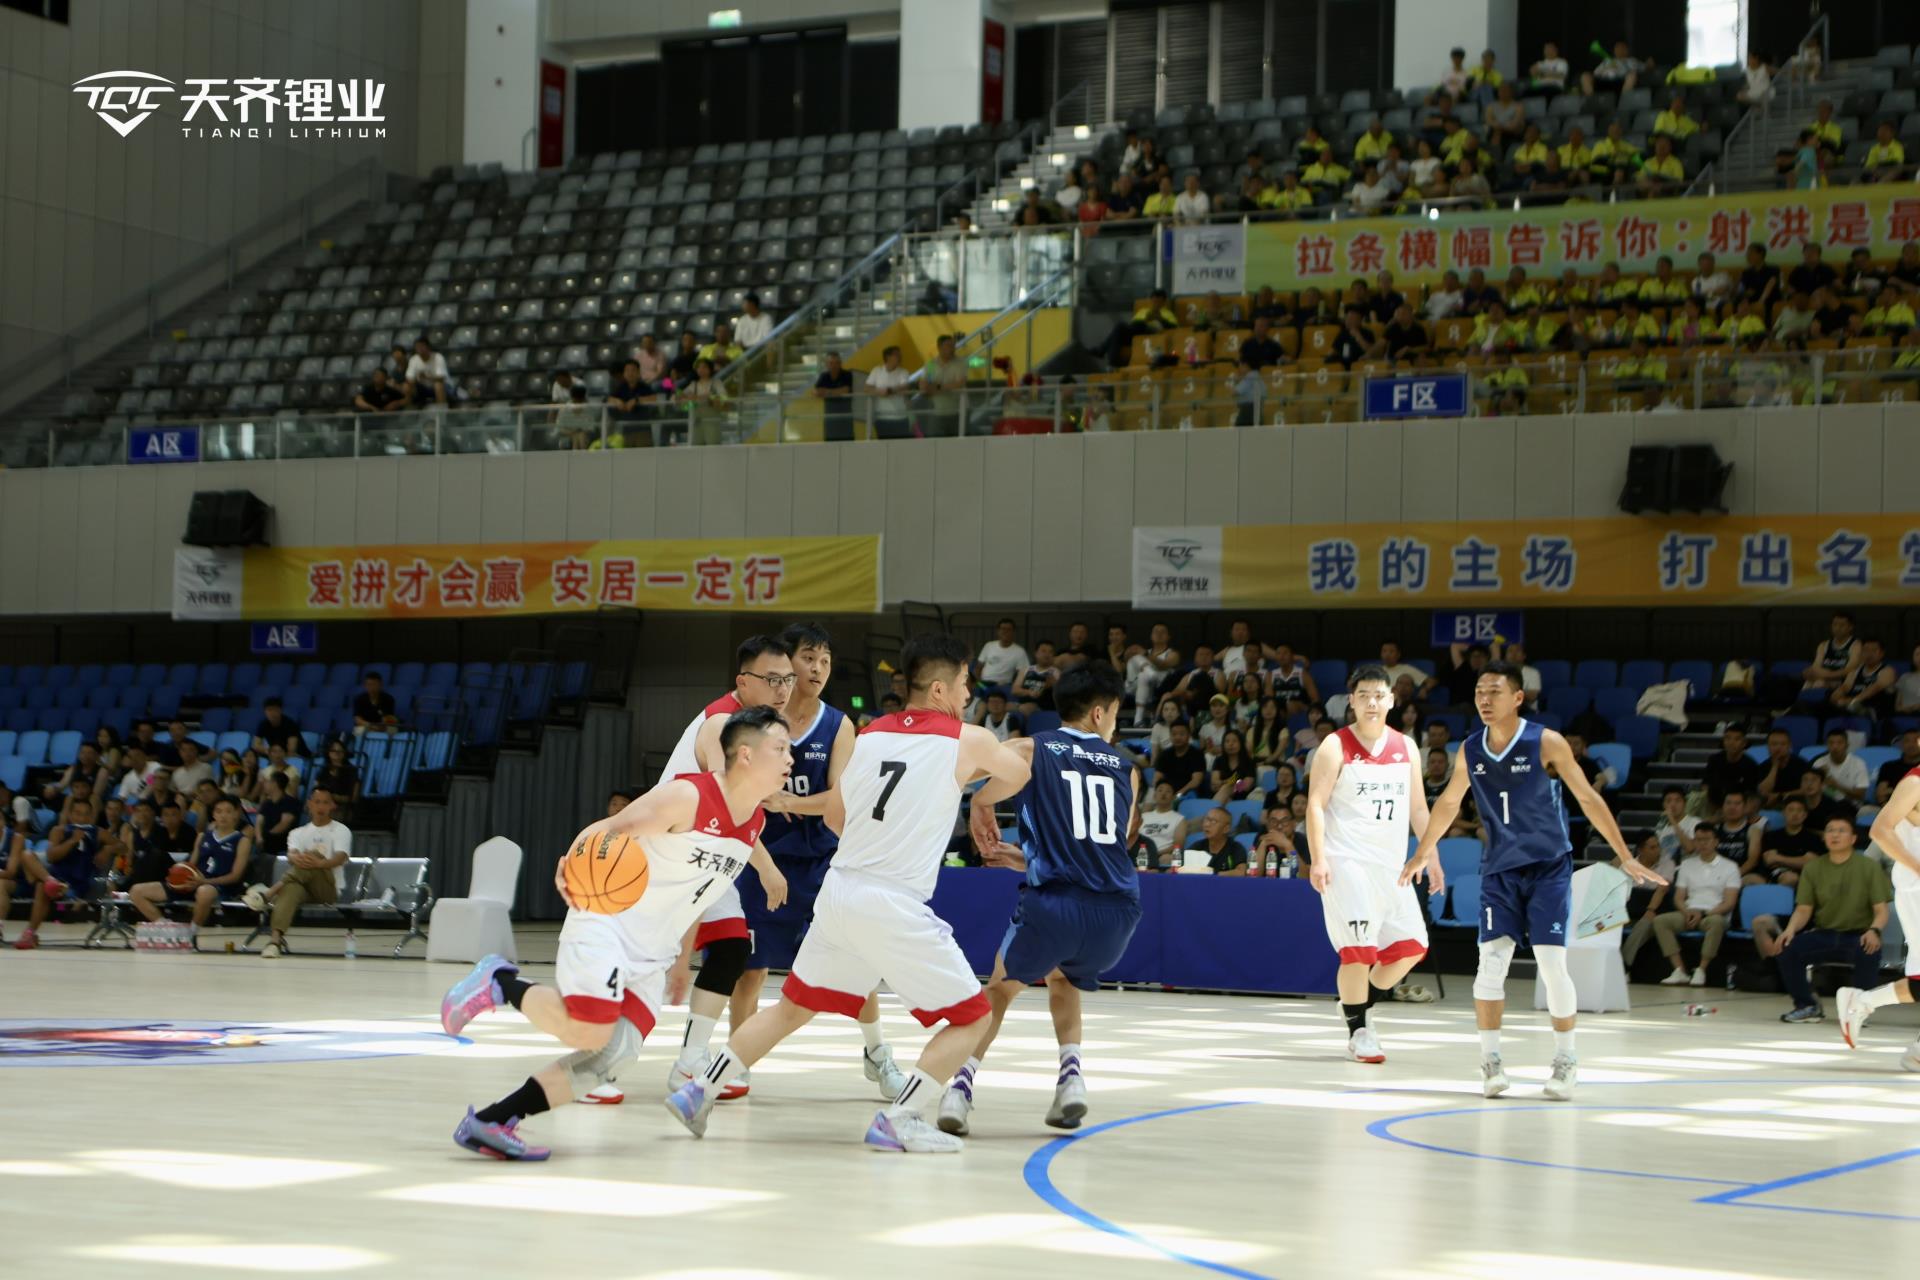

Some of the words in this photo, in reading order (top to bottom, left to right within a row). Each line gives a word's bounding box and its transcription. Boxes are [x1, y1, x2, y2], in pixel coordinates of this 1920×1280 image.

[1392, 381, 1438, 411] F区
[145, 431, 182, 456] A区
[1311, 538, 1574, 591] 我的主场
[309, 559, 522, 605] 爱拼才会赢
[554, 557, 781, 601] 安居一定行
[266, 624, 301, 648] A区
[1454, 613, 1498, 640] B区
[872, 760, 907, 822] 7
[1061, 769, 1117, 845] 10
[1372, 799, 1394, 821] 77
[1499, 791, 1510, 825] 1
[1348, 919, 1371, 943] 77
[1485, 905, 1494, 932] 1
[606, 967, 619, 998] 4
